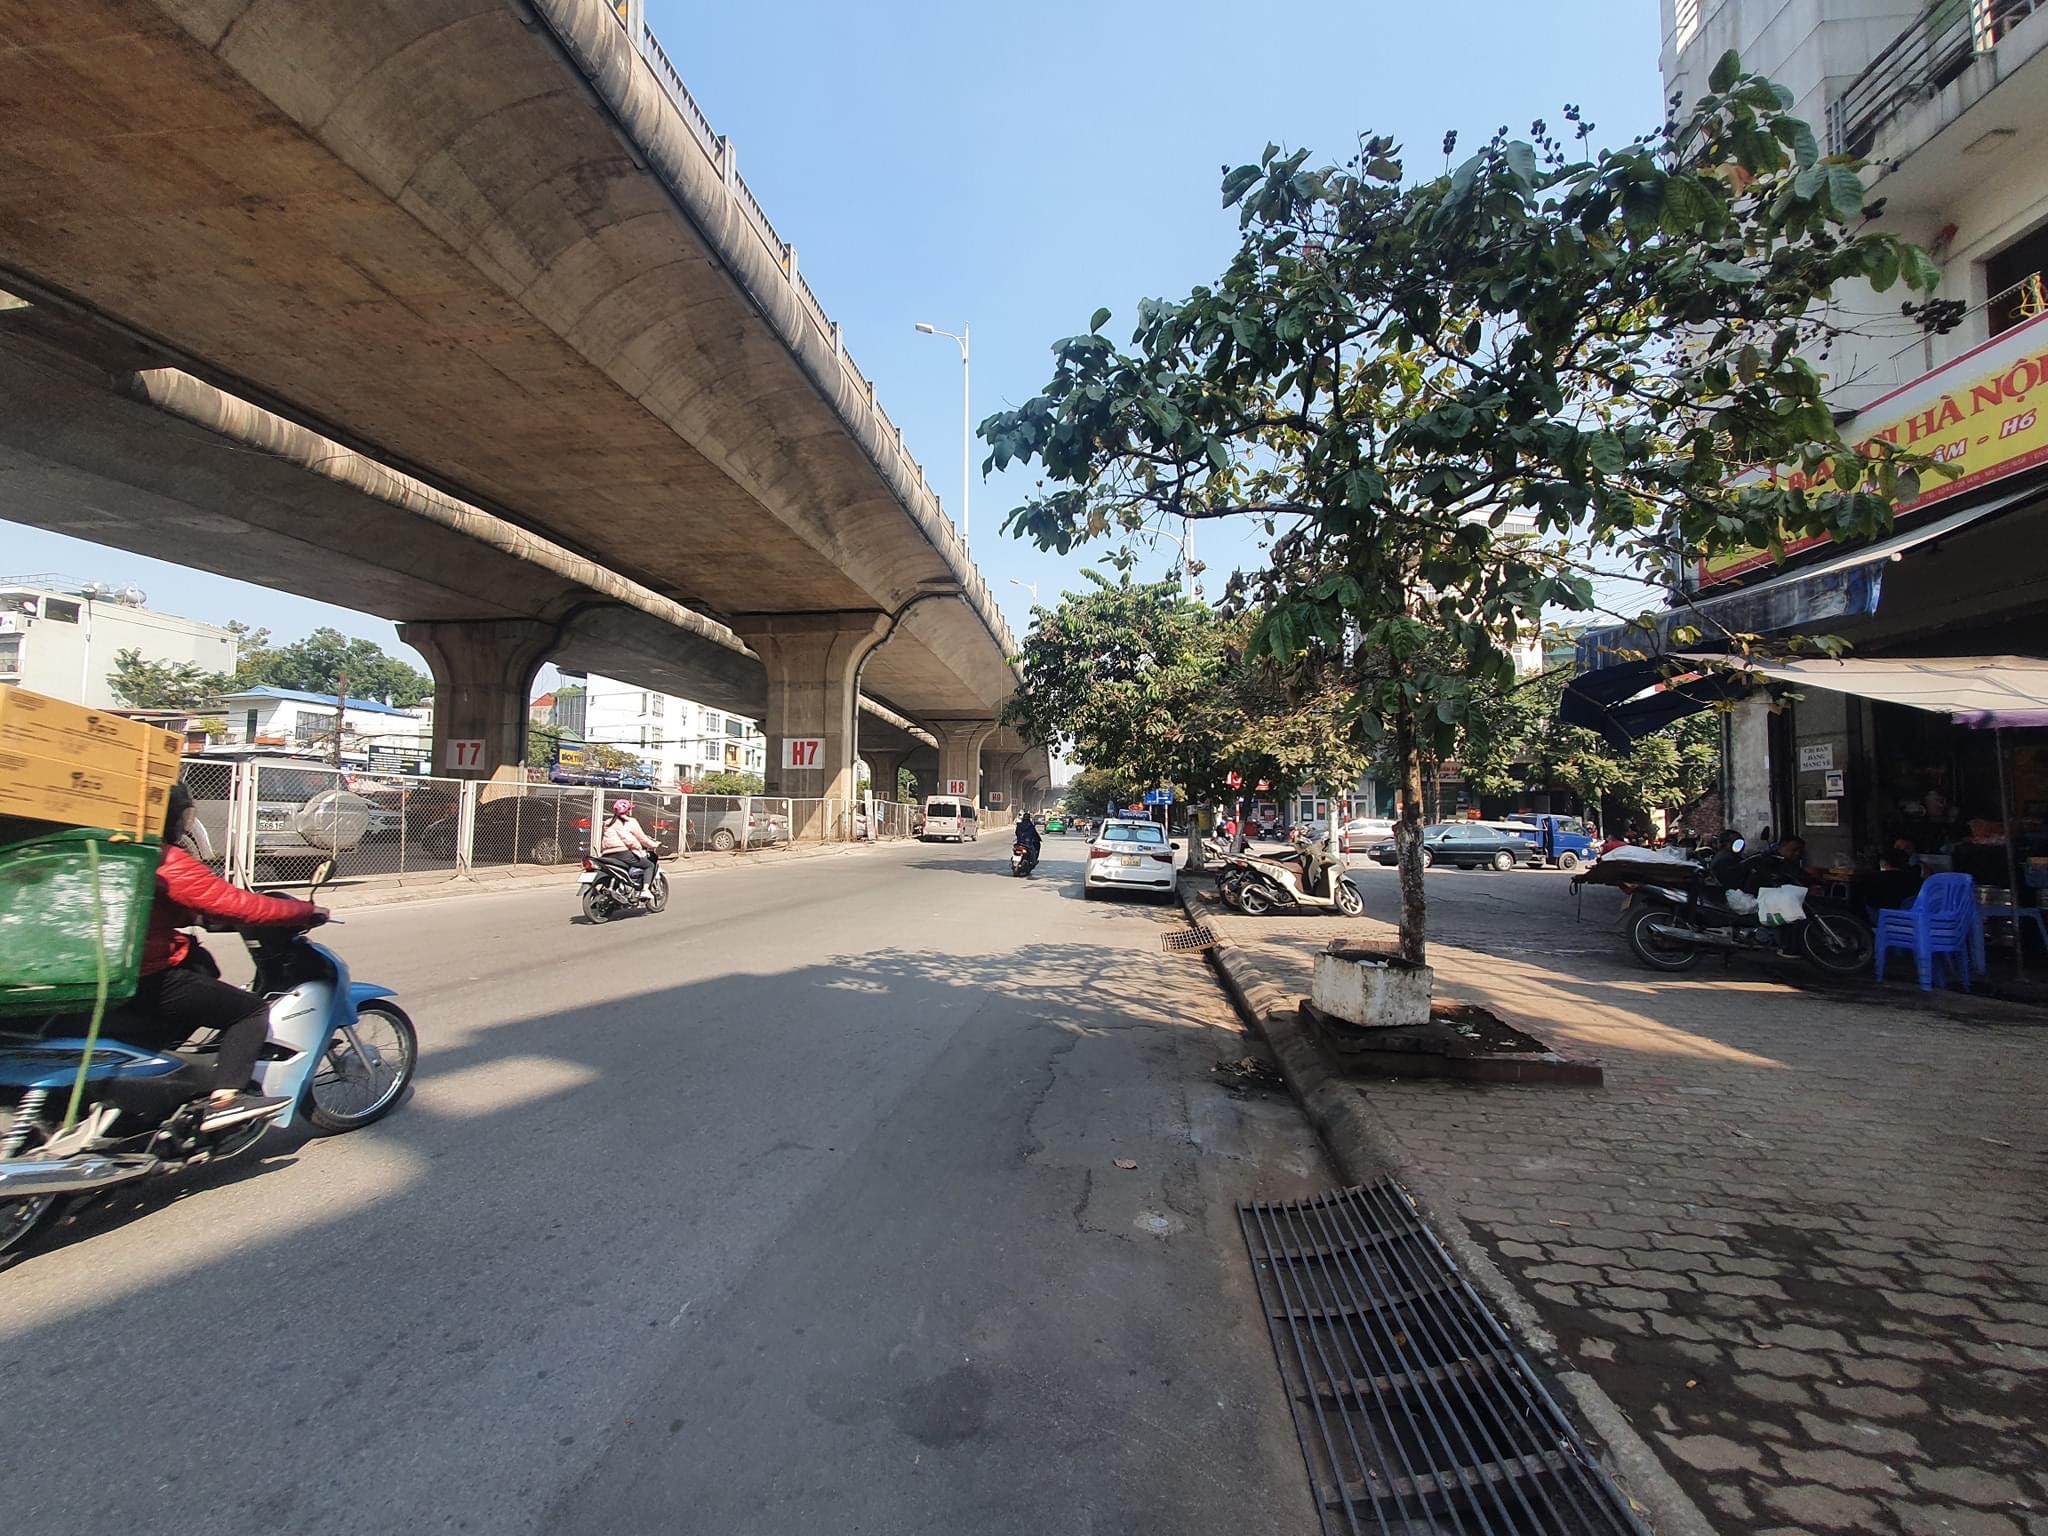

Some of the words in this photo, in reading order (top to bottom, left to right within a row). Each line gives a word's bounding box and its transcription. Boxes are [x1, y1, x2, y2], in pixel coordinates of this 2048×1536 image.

[1906, 394, 1966, 445] HÀ
[1999, 408, 2036, 440] H6
[456, 742, 481, 766] T7
[792, 741, 818, 766] H7
[950, 781, 964, 793] H8
